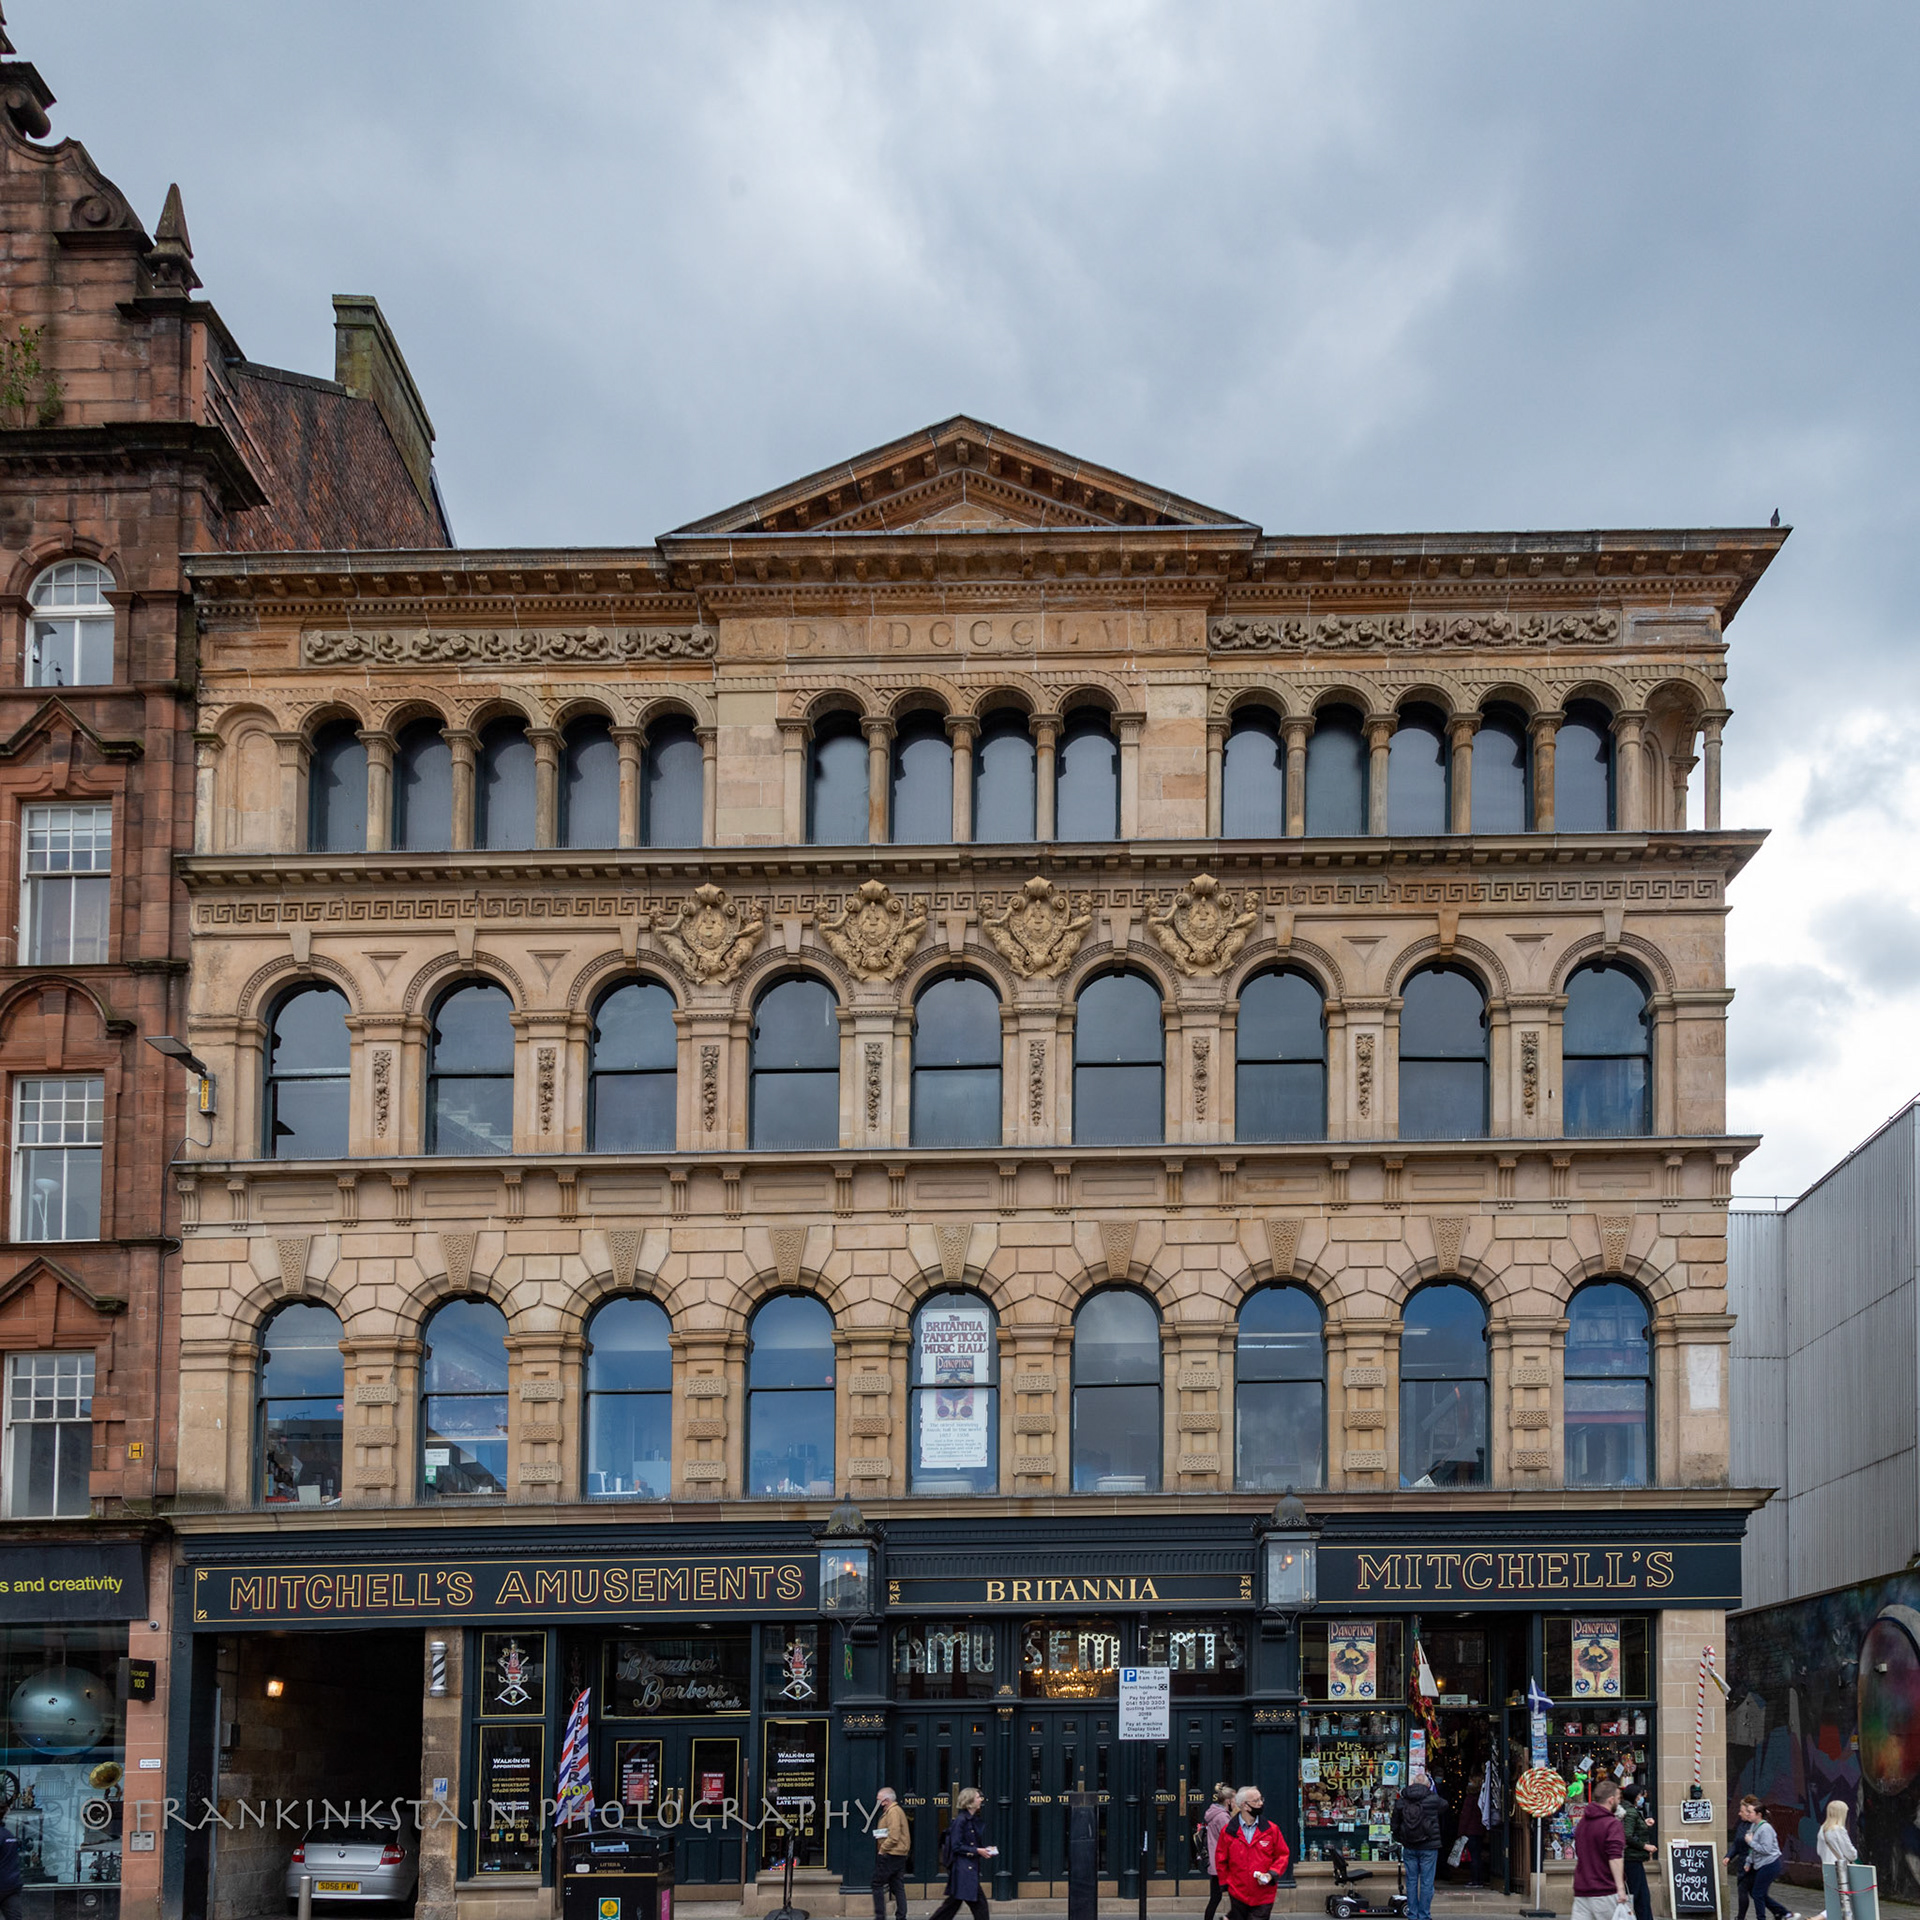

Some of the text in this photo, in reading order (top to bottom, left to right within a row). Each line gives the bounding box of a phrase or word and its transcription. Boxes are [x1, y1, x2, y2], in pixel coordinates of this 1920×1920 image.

[925, 1321, 984, 1332] BRITANNIA
[923, 1332, 987, 1342] PANOPTICON
[924, 1343, 986, 1354] MUSIC HALL
[1357, 1550, 1675, 1590] MITCHELL'S
[13, 1577, 45, 1592] and
[49, 1575, 123, 1594] creativity
[230, 1564, 803, 1611] MITCHELL'S AMUSEMENTS
[986, 1577, 1160, 1602] BRITANNIA
[1331, 1621, 1374, 1641] PANOPTICON
[1574, 1619, 1617, 1638] PANOPTICON
[616, 1646, 718, 1681] Brazuca
[133, 1678, 146, 1689] 103
[633, 1674, 728, 1710] Barbers
[1336, 1741, 1366, 1751] Mrs.
[1326, 1777, 1378, 1791] SHOP
[561, 1784, 590, 1799] SHOP
[1155, 1794, 1177, 1802] MIND
[904, 1797, 949, 1805] MIND THE
[1058, 1795, 1069, 1803] TH
[340, 1882, 357, 1891] FWU
[1681, 1885, 1710, 1902] Rock
